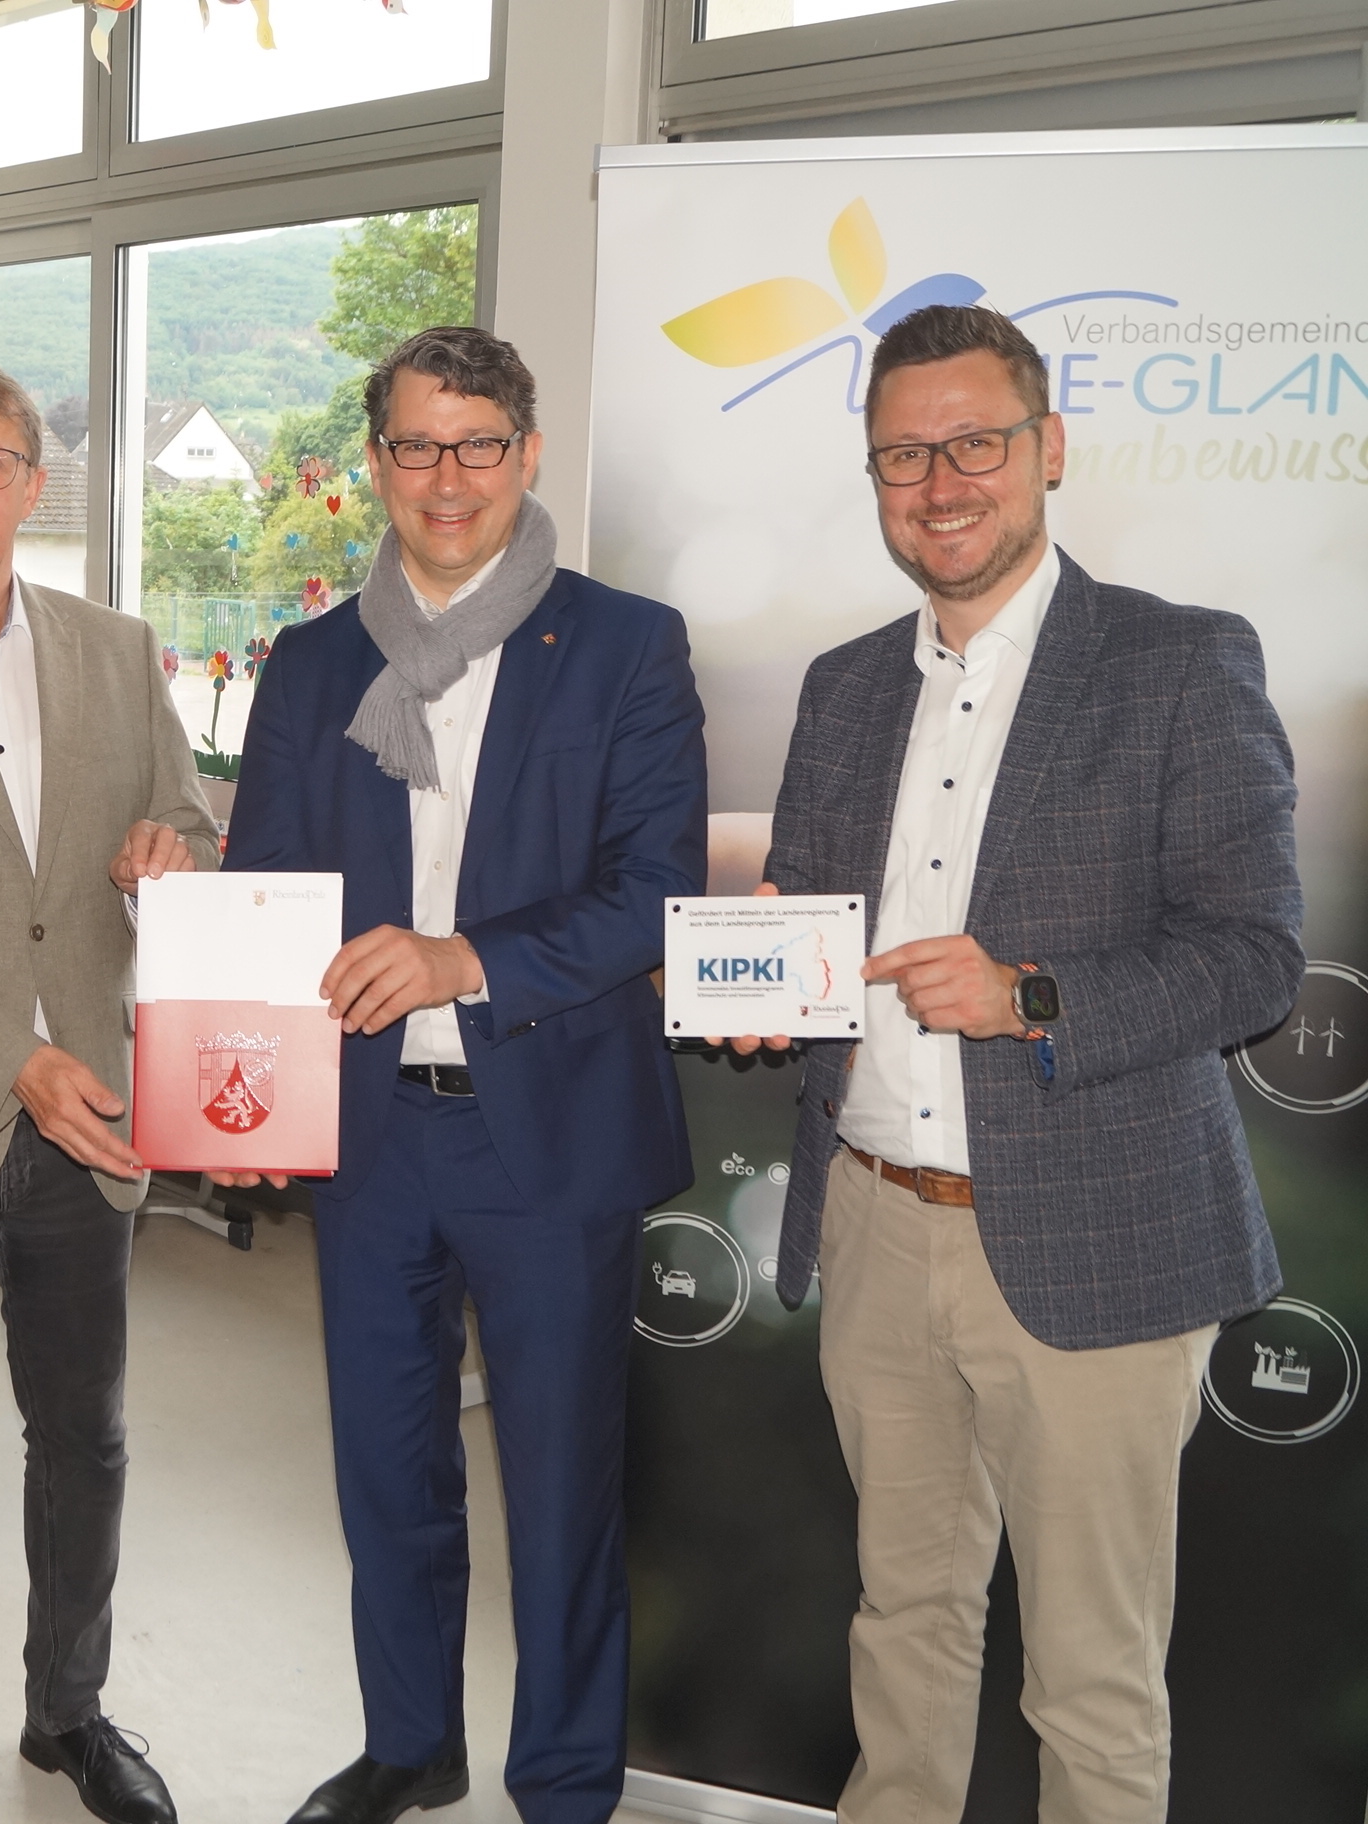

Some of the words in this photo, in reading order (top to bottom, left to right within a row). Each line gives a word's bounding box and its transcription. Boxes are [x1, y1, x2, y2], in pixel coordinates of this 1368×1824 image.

[1043, 353, 1368, 416] E-GLAN
[697, 957, 784, 982] KIPKI
[721, 1159, 755, 1177] eco
